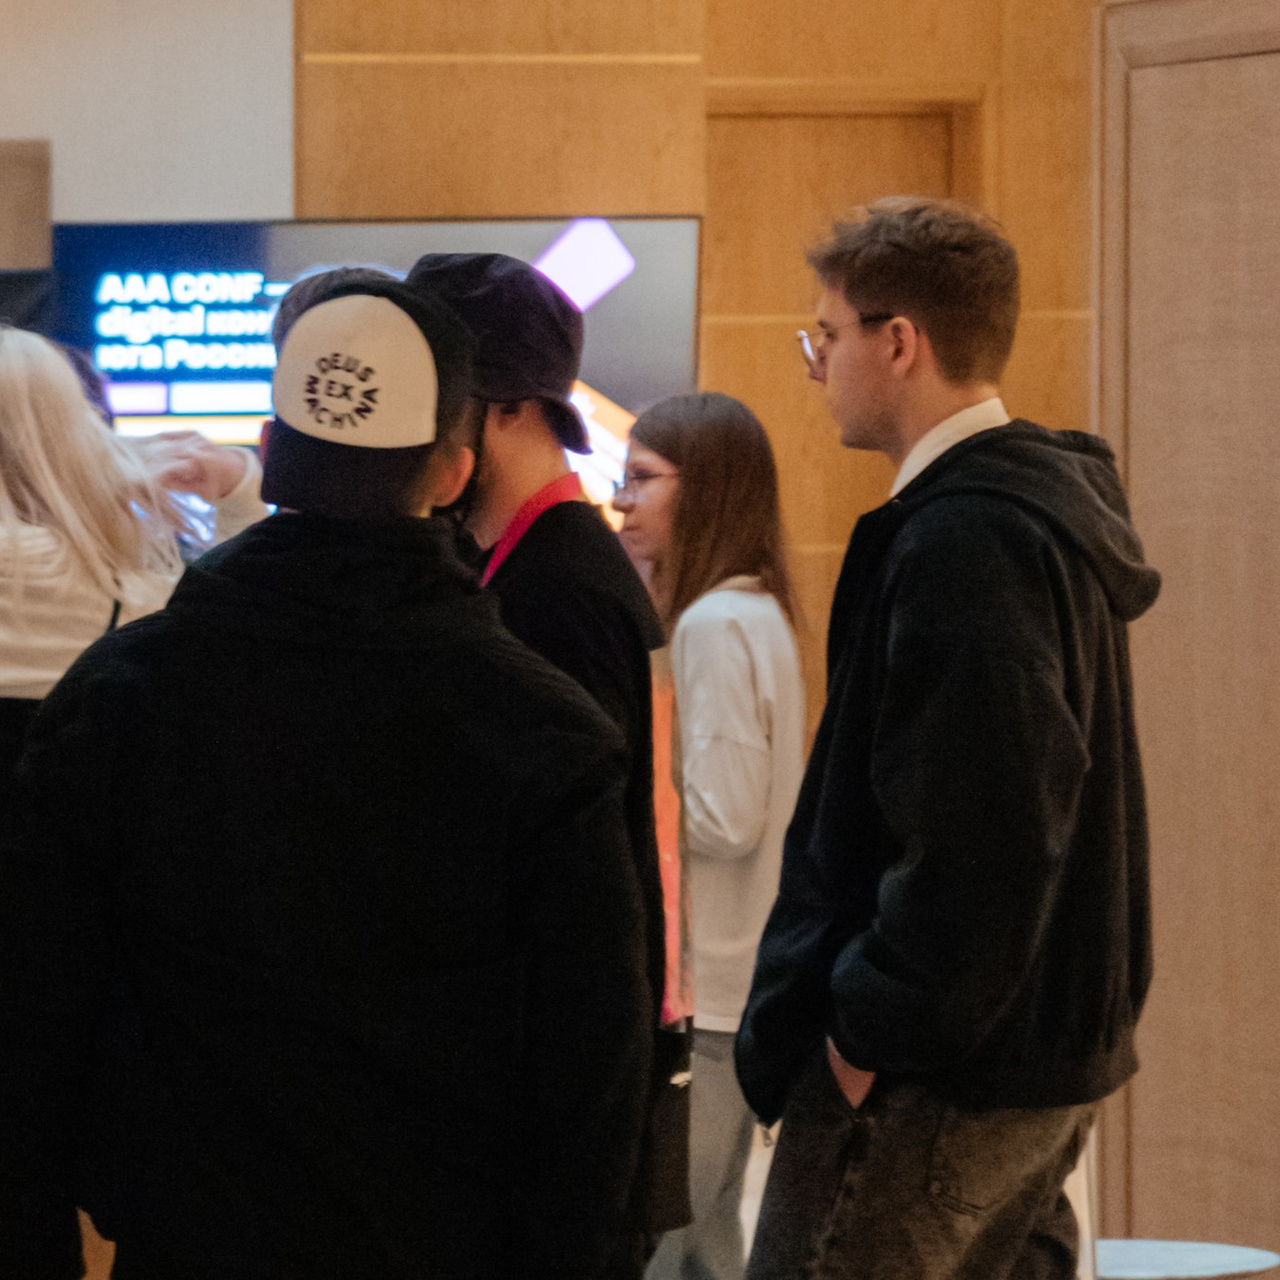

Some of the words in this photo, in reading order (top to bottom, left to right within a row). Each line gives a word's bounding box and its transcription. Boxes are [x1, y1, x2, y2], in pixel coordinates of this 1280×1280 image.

[171, 272, 264, 304] CONF
[95, 304, 205, 343] digital
[315, 352, 375, 382] DEUS
[305, 374, 380, 429] MACHINA
[325, 379, 354, 401] EX
